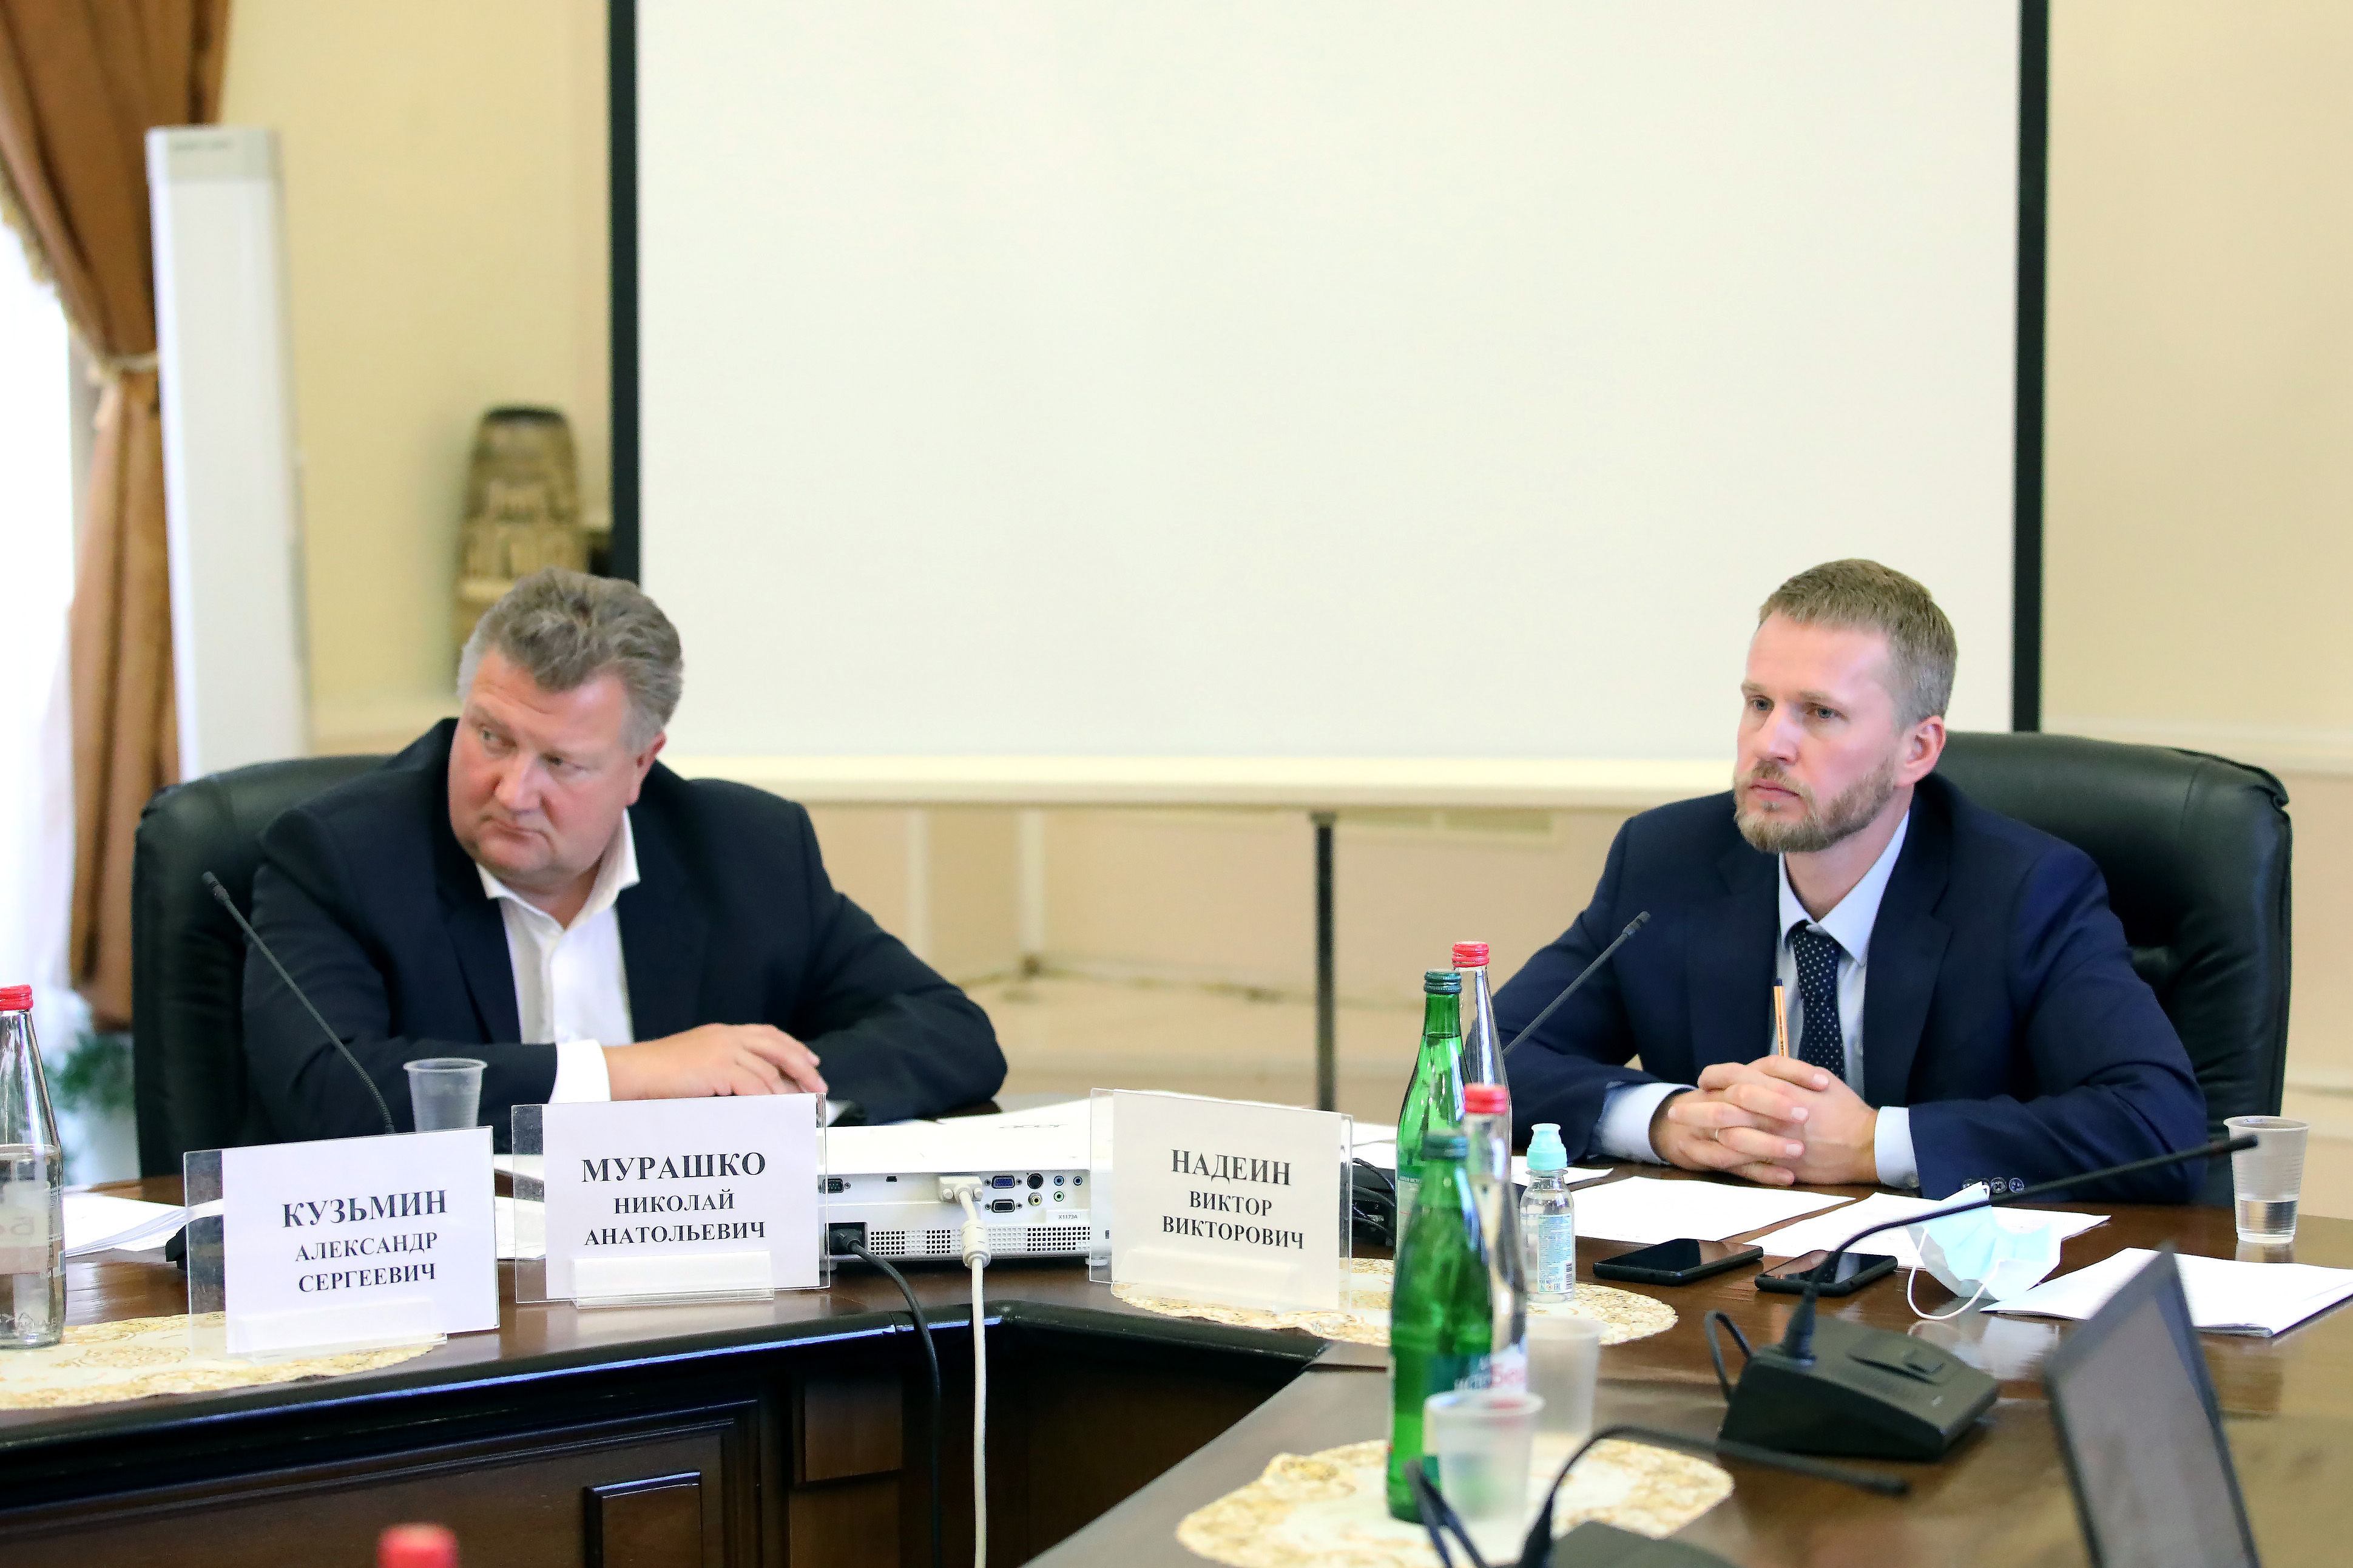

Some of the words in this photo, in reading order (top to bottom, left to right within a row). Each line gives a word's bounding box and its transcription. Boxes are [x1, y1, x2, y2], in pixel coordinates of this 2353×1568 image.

[581, 1152, 766, 1183] МУРАШКО
[1171, 1149, 1291, 1186] НАДЕИН
[283, 1190, 446, 1228] КУЗЬМИН
[613, 1188, 734, 1214] НИКОЛАЙ
[1190, 1191, 1272, 1216] ВИКТОР
[295, 1231, 438, 1262] АЛЕКСАНДР
[584, 1222, 766, 1246] АНАТОЛЬЕВИЧ
[1163, 1215, 1303, 1249] ВИКТОРОВИЧ
[299, 1263, 434, 1293] СЕРГЕЕВИЧ
